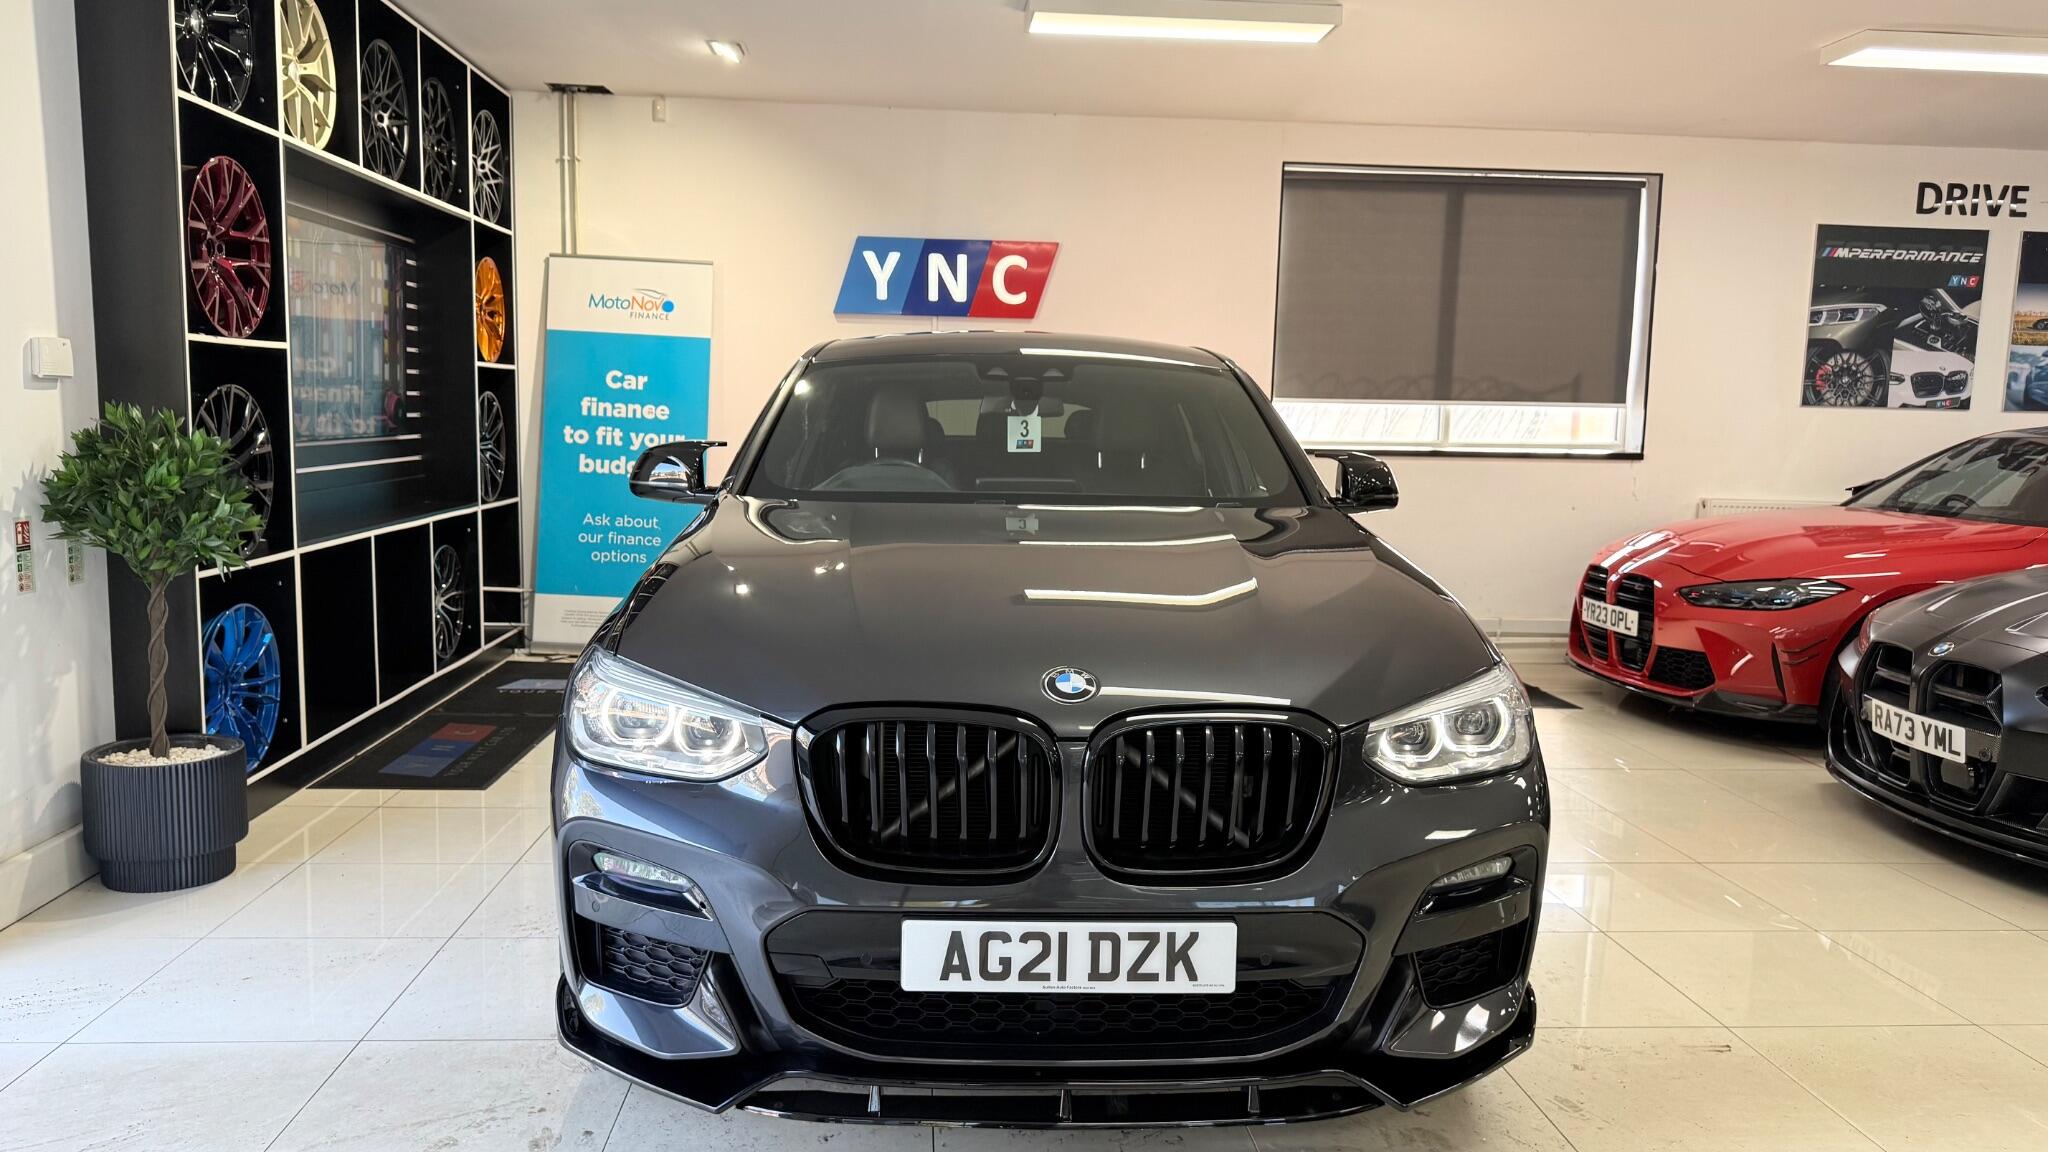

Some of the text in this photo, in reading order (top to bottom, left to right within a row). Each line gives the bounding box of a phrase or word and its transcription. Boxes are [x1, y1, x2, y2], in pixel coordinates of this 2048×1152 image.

[1915, 181, 2030, 218] DRIVE
[862, 250, 1028, 305] YNC
[1951, 275, 1976, 287] YNC
[629, 311, 670, 321] FINANCE
[605, 369, 648, 390] Car
[581, 396, 670, 420] finance
[563, 425, 589, 444] to
[595, 426, 623, 447] fit
[1020, 419, 1030, 438] 3
[578, 453, 638, 477] bud
[582, 512, 659, 529] Ask about
[578, 531, 662, 547] our finance
[590, 549, 647, 564] options
[1585, 600, 1632, 631] YR23 OPL
[1874, 703, 1961, 757] RA73 YML
[939, 930, 1200, 982] AG21 DZK
